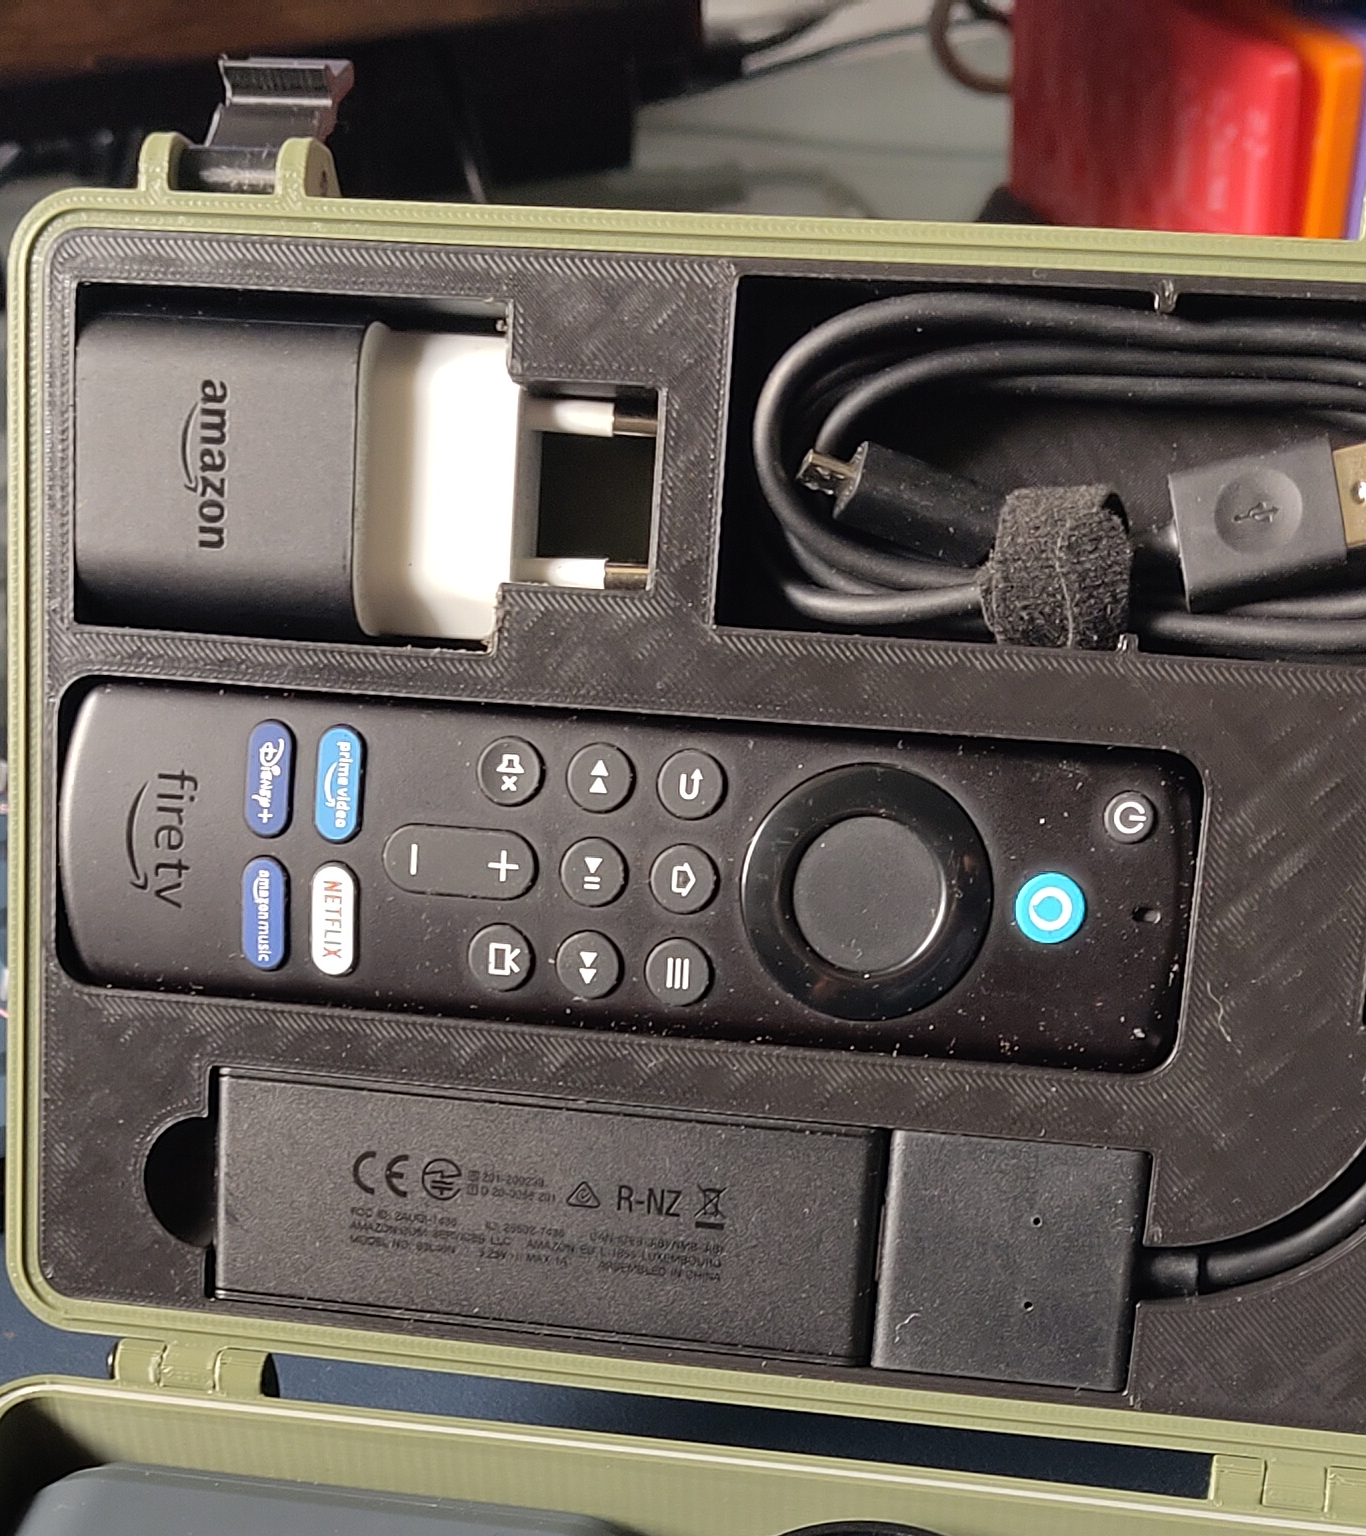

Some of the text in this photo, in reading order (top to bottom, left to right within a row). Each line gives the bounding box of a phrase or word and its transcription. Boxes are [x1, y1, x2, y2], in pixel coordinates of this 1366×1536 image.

[198, 379, 228, 550] amazon
[252, 738, 285, 824] Disney+
[322, 880, 343, 959] NETFLIX
[617, 1185, 682, 1217] R-NZ
